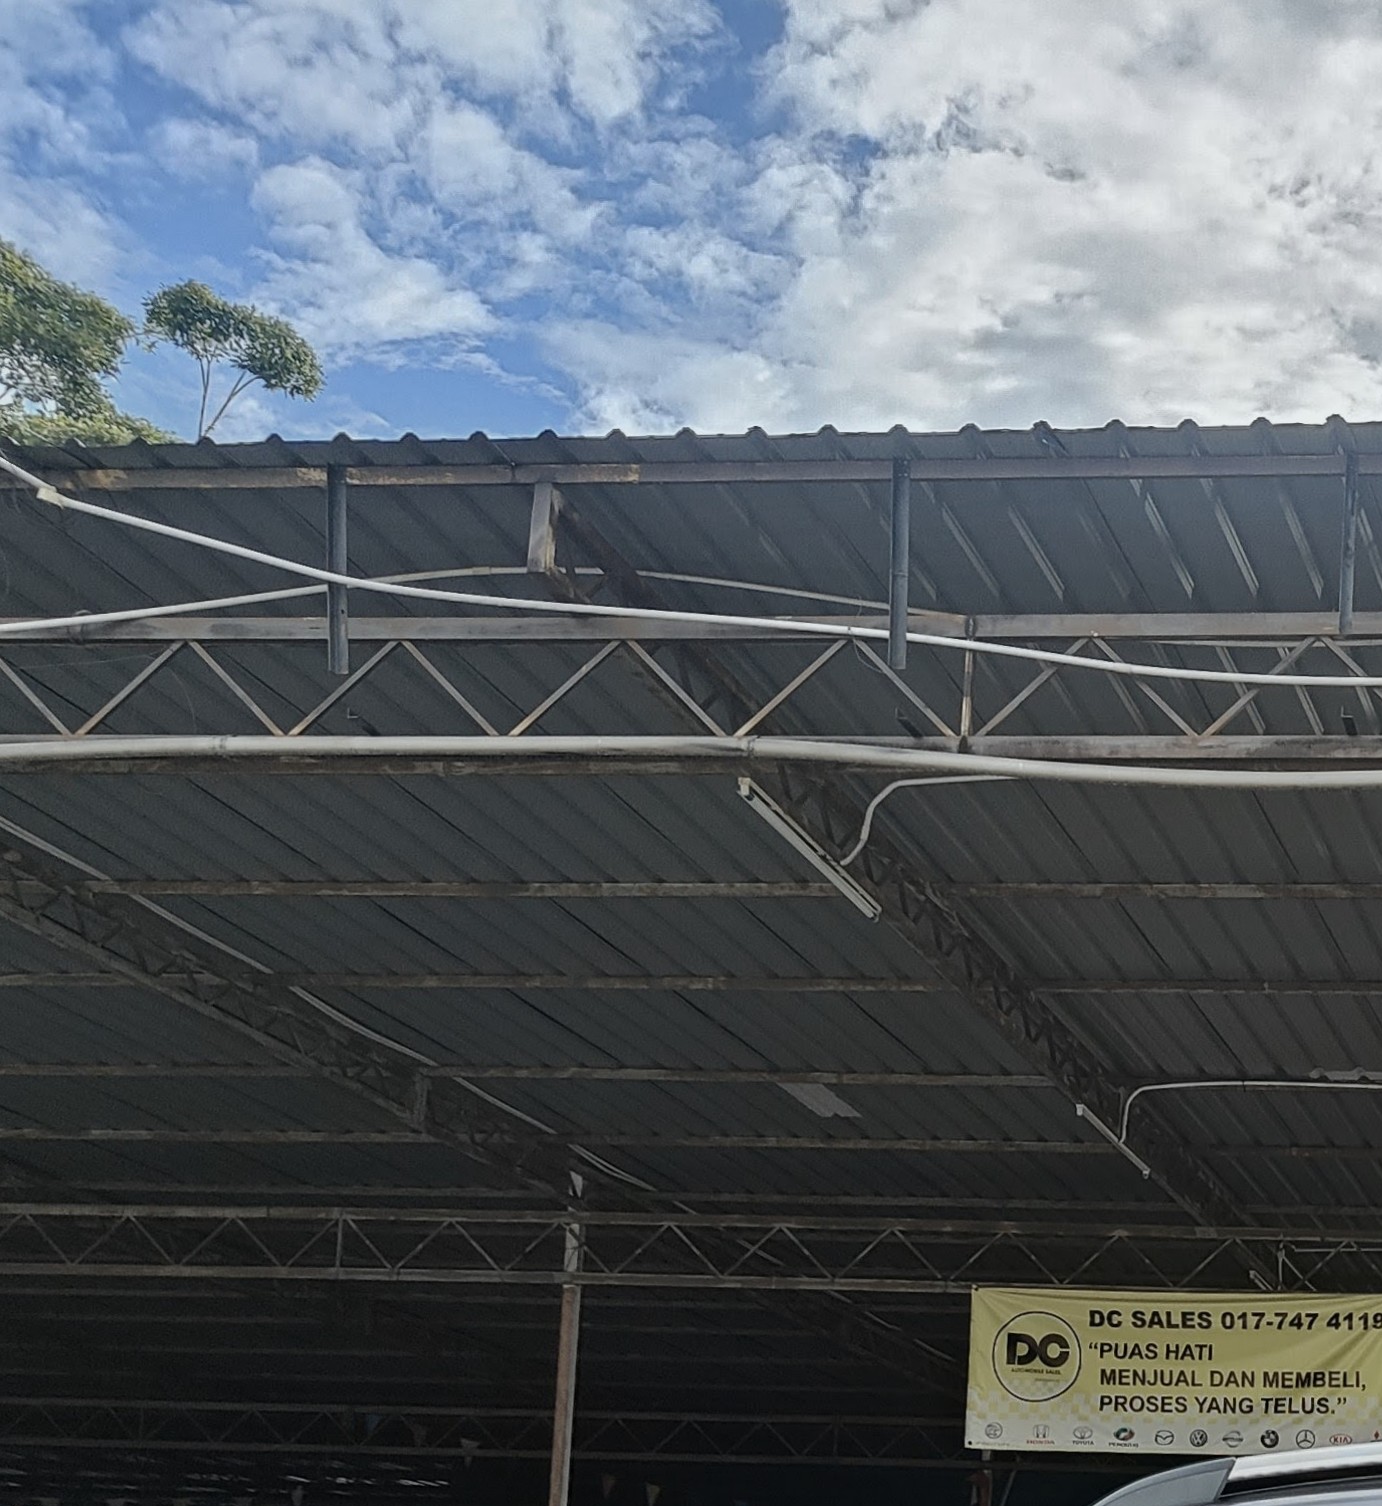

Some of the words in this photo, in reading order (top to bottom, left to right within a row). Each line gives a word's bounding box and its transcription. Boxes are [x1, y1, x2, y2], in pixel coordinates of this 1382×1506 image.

[1089, 1310, 1123, 1328] DC
[1131, 1311, 1212, 1329] SALES
[1221, 1312, 1319, 1330] 017-747
[1006, 1332, 1070, 1368] DC
[1088, 1342, 1158, 1361] “PUAS
[1165, 1343, 1213, 1361] HATI
[1100, 1368, 1203, 1387] MENJUAL
[1209, 1370, 1255, 1388] DAN
[1263, 1371, 1366, 1391] MEMBELI,
[1099, 1395, 1187, 1413] PROSES
[1194, 1396, 1254, 1414] YANG
[1261, 1397, 1347, 1414] TELUS.”
